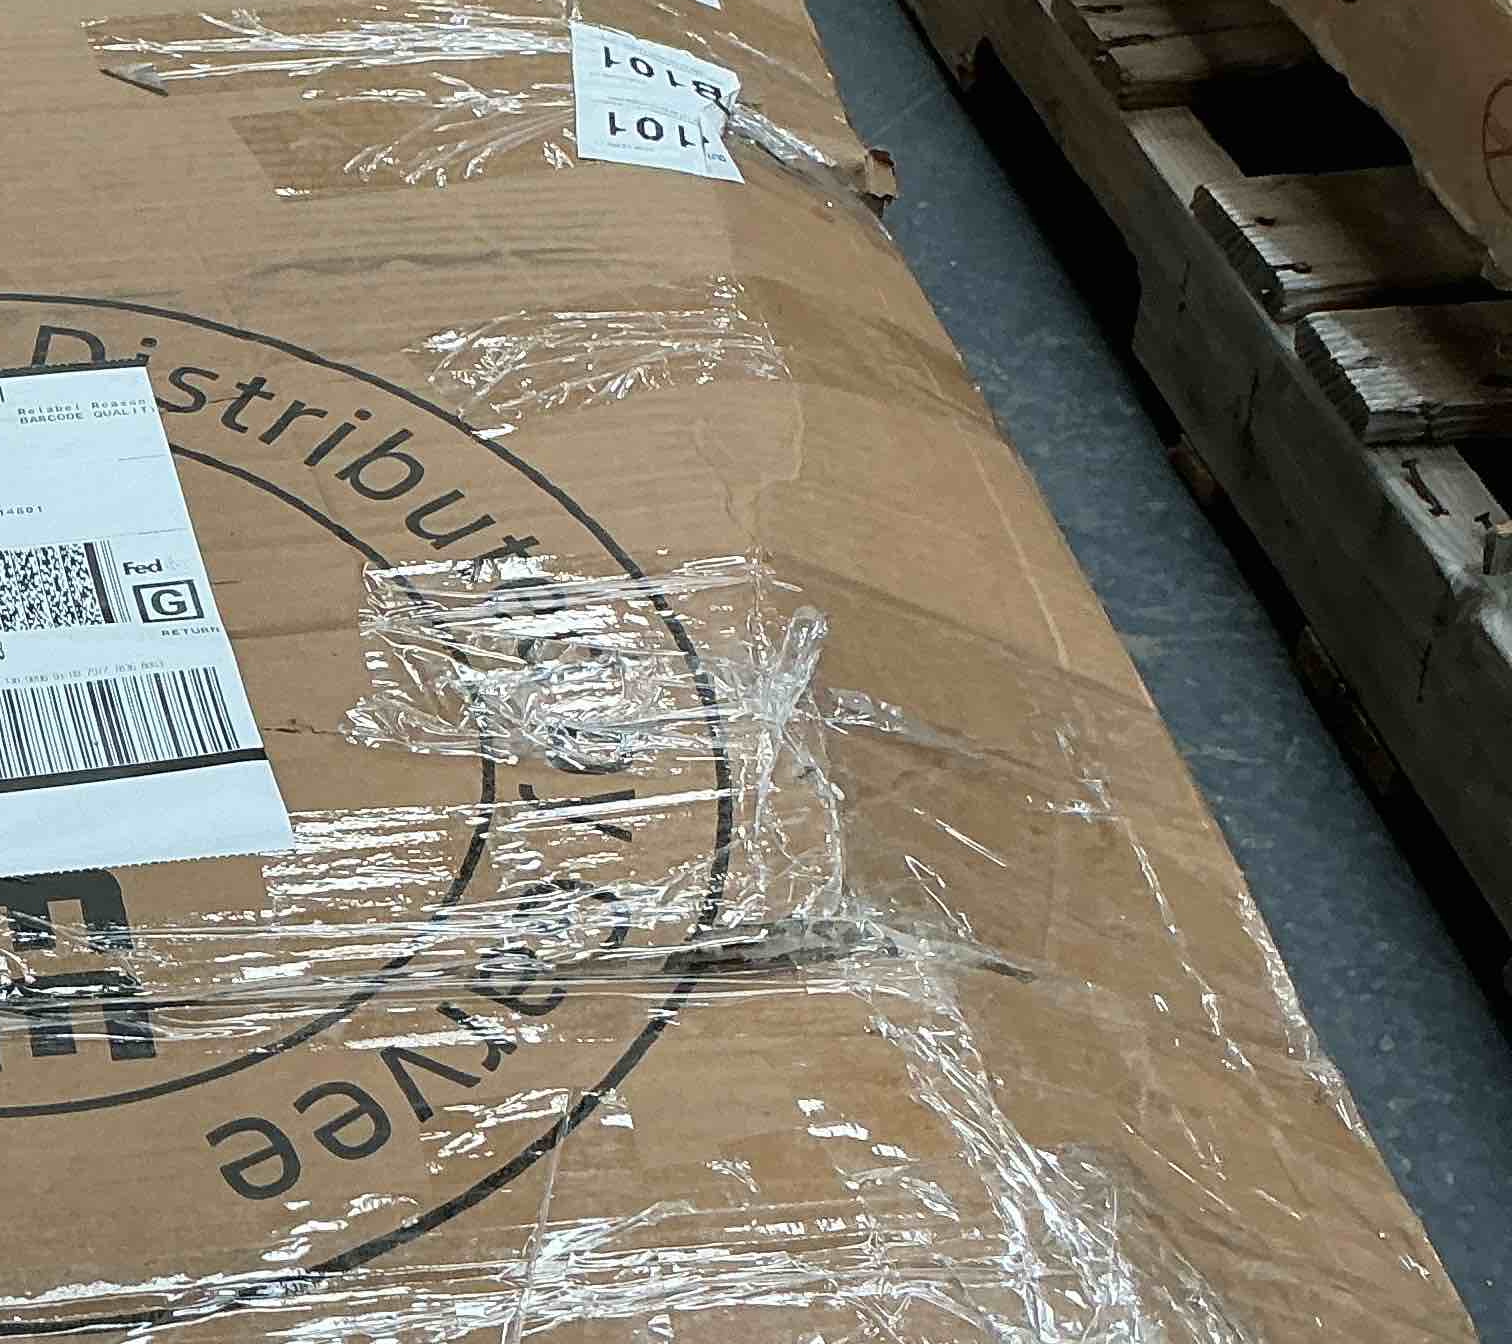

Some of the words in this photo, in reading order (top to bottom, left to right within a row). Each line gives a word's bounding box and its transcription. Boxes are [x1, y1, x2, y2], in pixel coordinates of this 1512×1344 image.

[19, 412, 84, 425] BARCODE
[151, 589, 188, 616] G
[161, 625, 221, 637] RETURN
